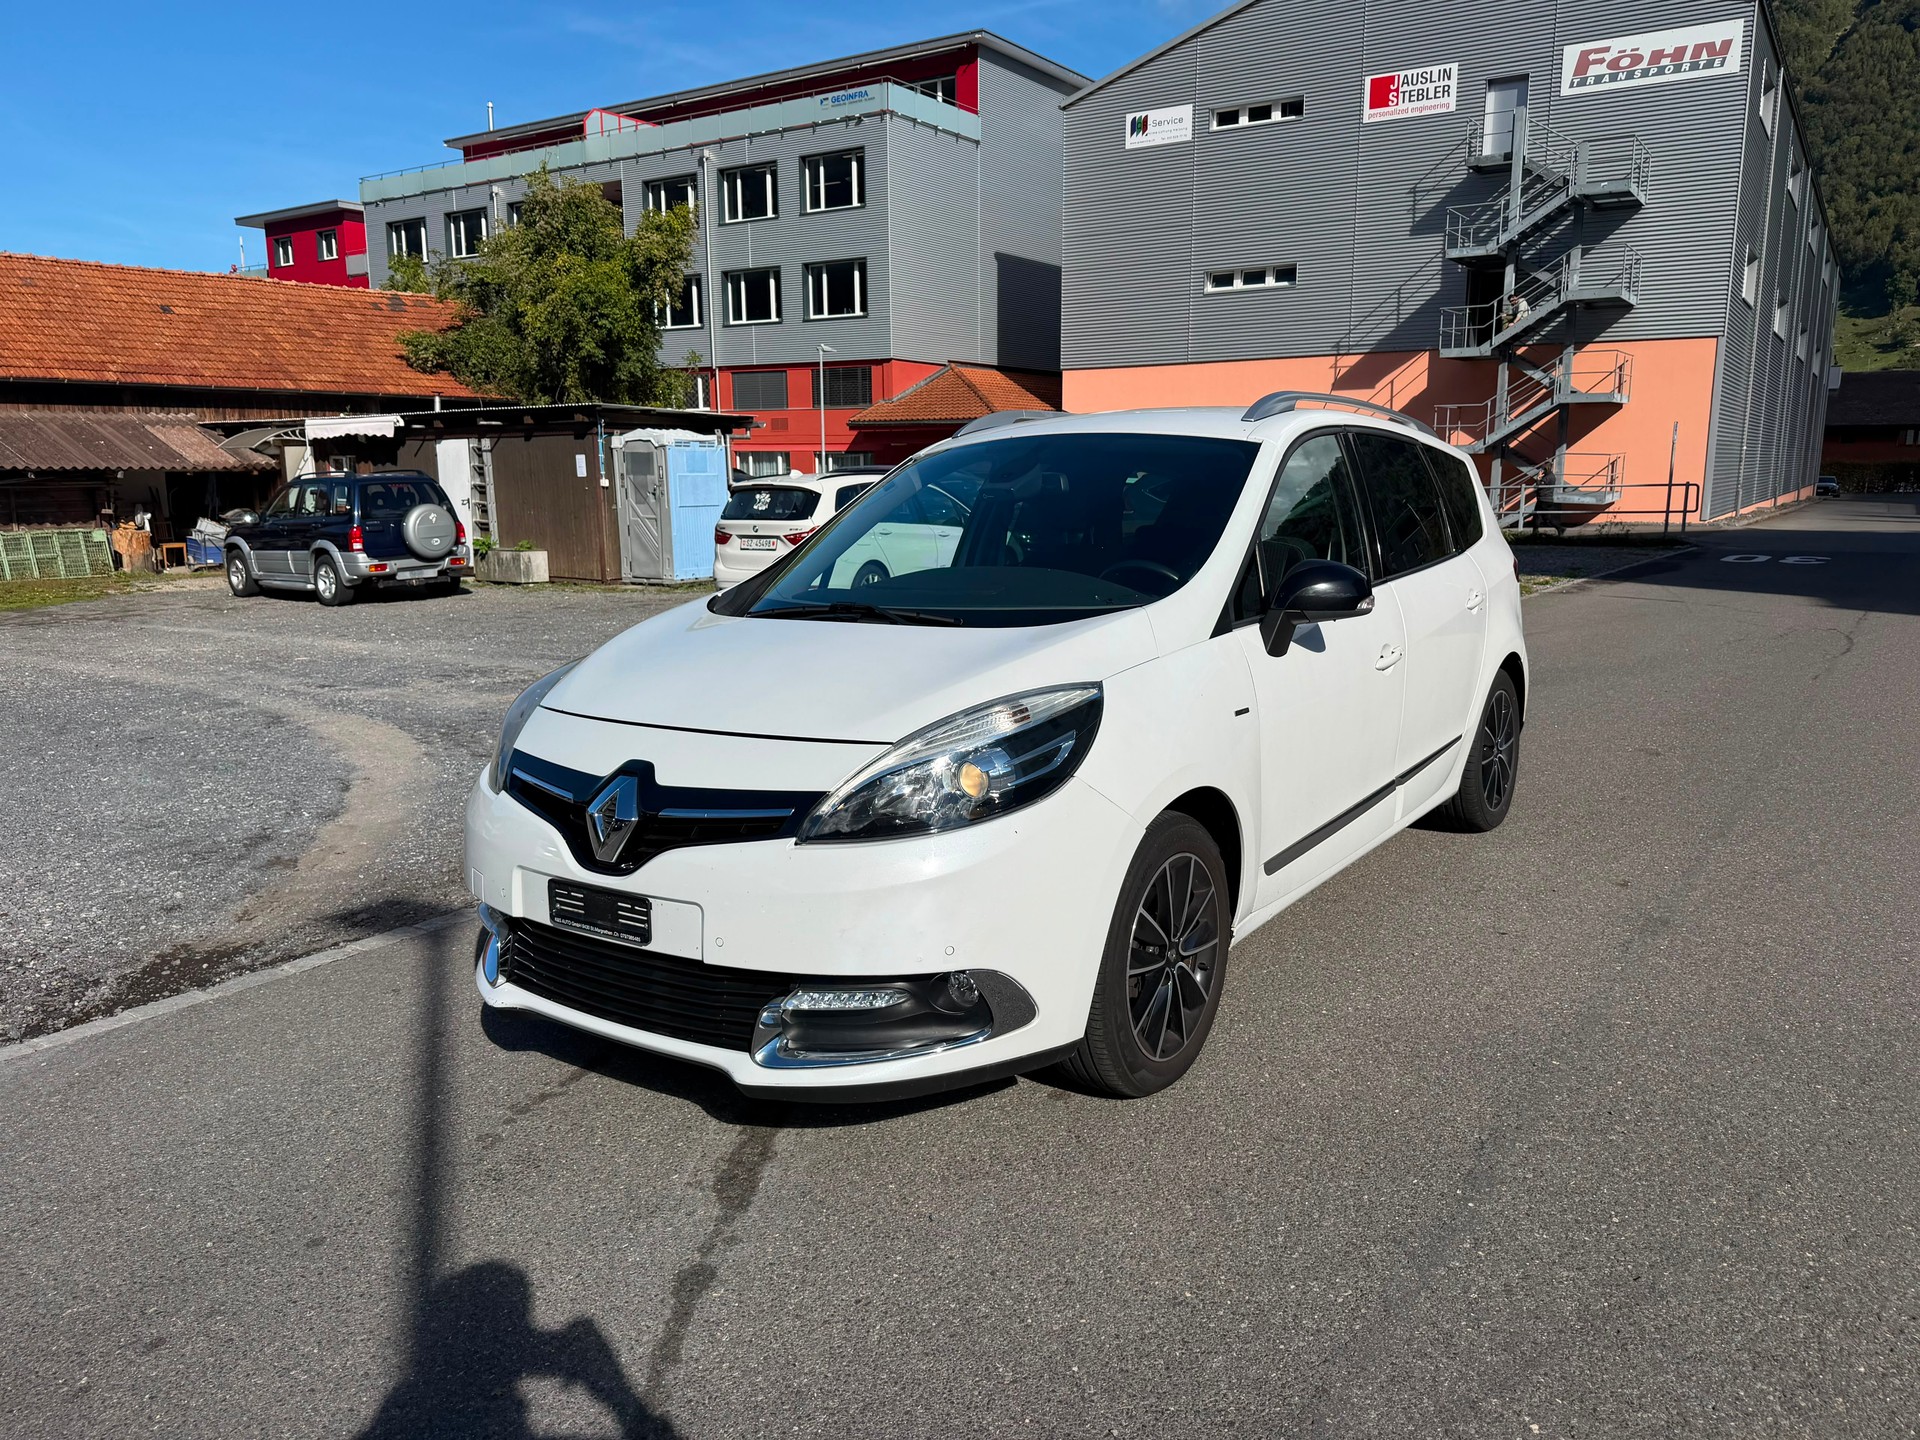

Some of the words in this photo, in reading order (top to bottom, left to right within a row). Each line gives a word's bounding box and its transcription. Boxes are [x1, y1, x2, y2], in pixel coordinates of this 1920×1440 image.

[1572, 38, 1734, 77] FÖHN
[1571, 57, 1724, 88] TRANSPORTE
[831, 90, 869, 104] GEOINFRA
[1388, 84, 1451, 106] STEBLER
[1368, 107, 1409, 120] personalized
[1410, 102, 1450, 114] engineering
